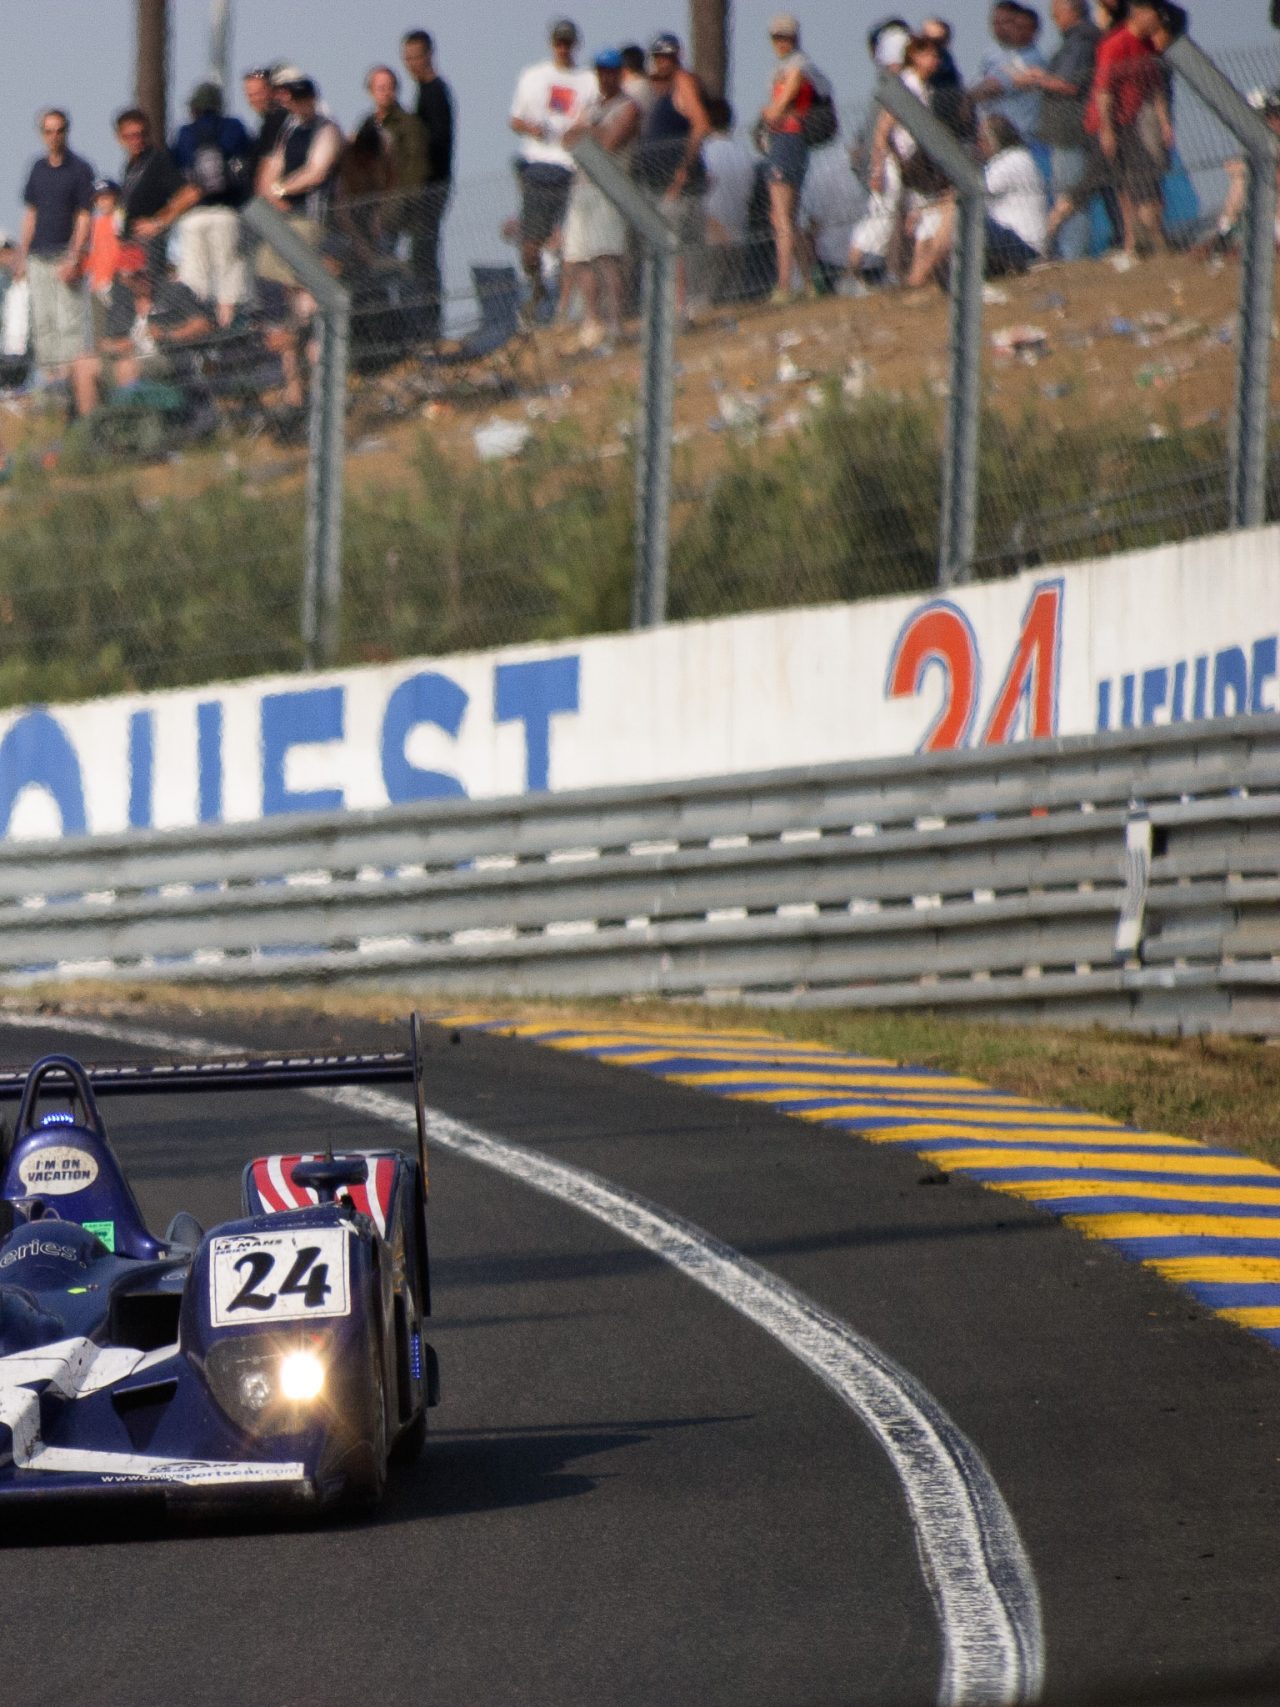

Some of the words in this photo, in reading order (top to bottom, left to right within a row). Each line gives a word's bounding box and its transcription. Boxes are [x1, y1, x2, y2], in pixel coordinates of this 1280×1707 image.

[884, 577, 1066, 754] 24
[28, 1170, 91, 1181] VACATION
[61, 1159, 80, 1169] ON
[225, 1246, 332, 1313] 24
